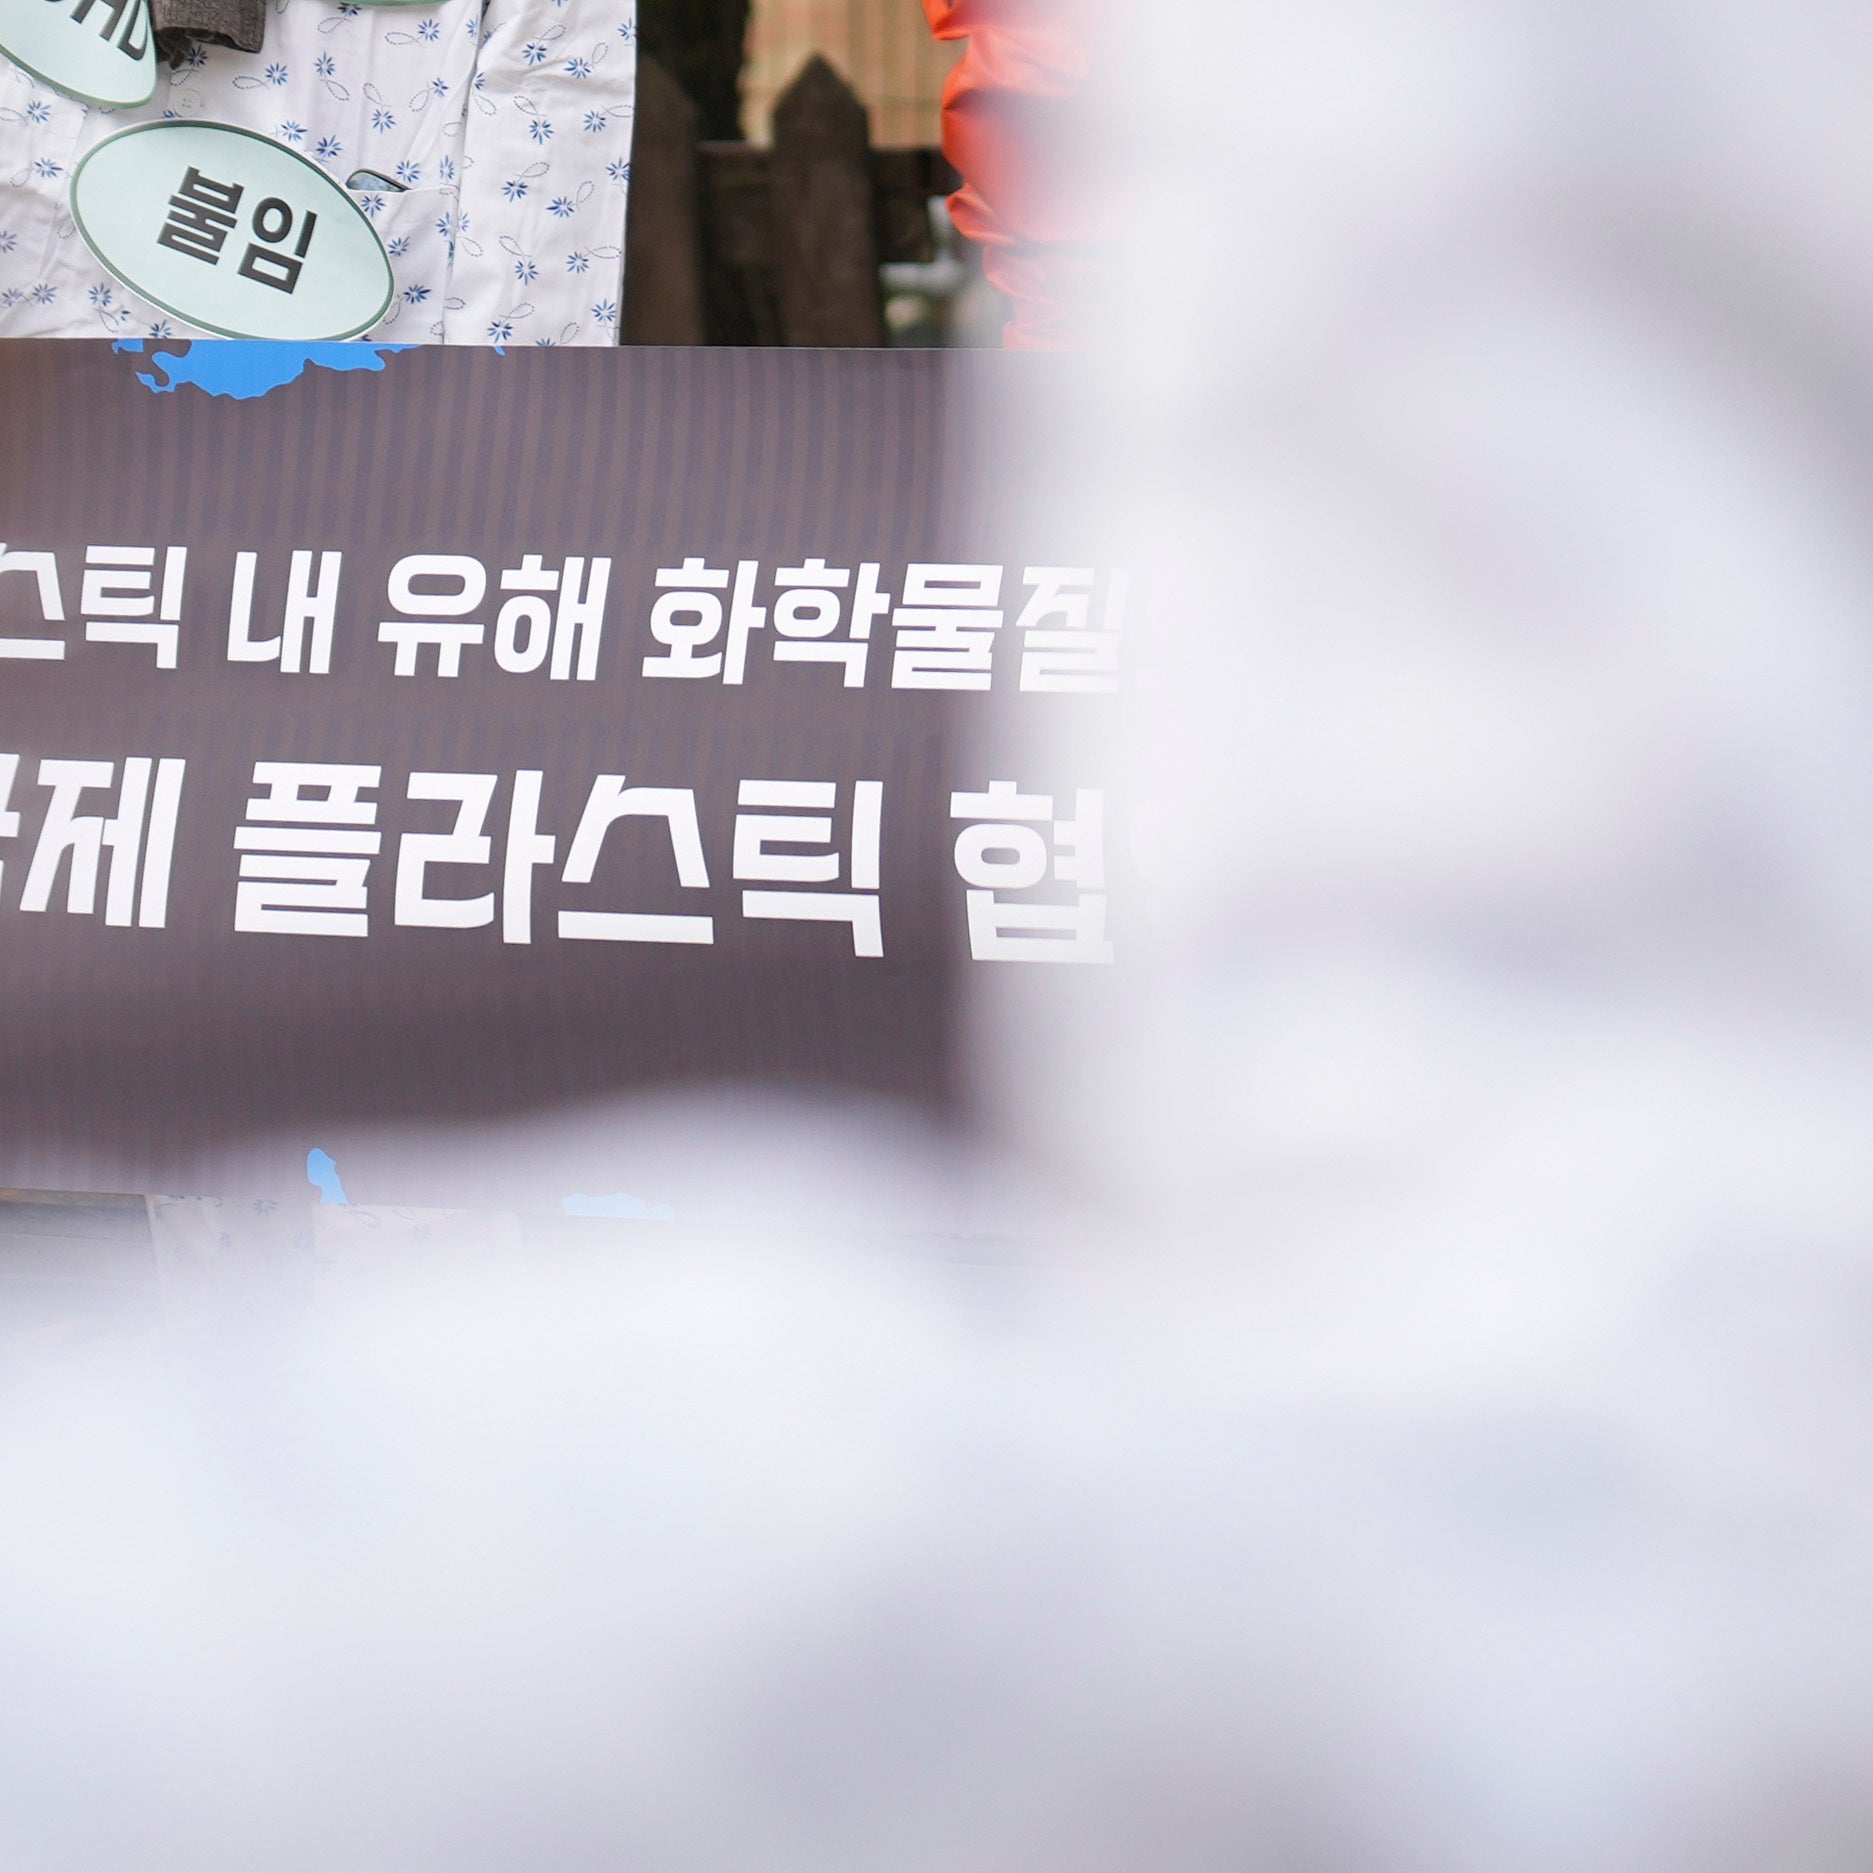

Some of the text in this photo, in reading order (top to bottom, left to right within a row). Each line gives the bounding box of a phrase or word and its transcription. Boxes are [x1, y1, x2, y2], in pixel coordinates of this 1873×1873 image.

[156, 165, 318, 295] 불임
[226, 549, 343, 675] 내
[377, 553, 612, 681] 유해
[641, 557, 1126, 693] 화학물질
[233, 761, 884, 958] 플라스틱
[949, 780, 1120, 965] 협
